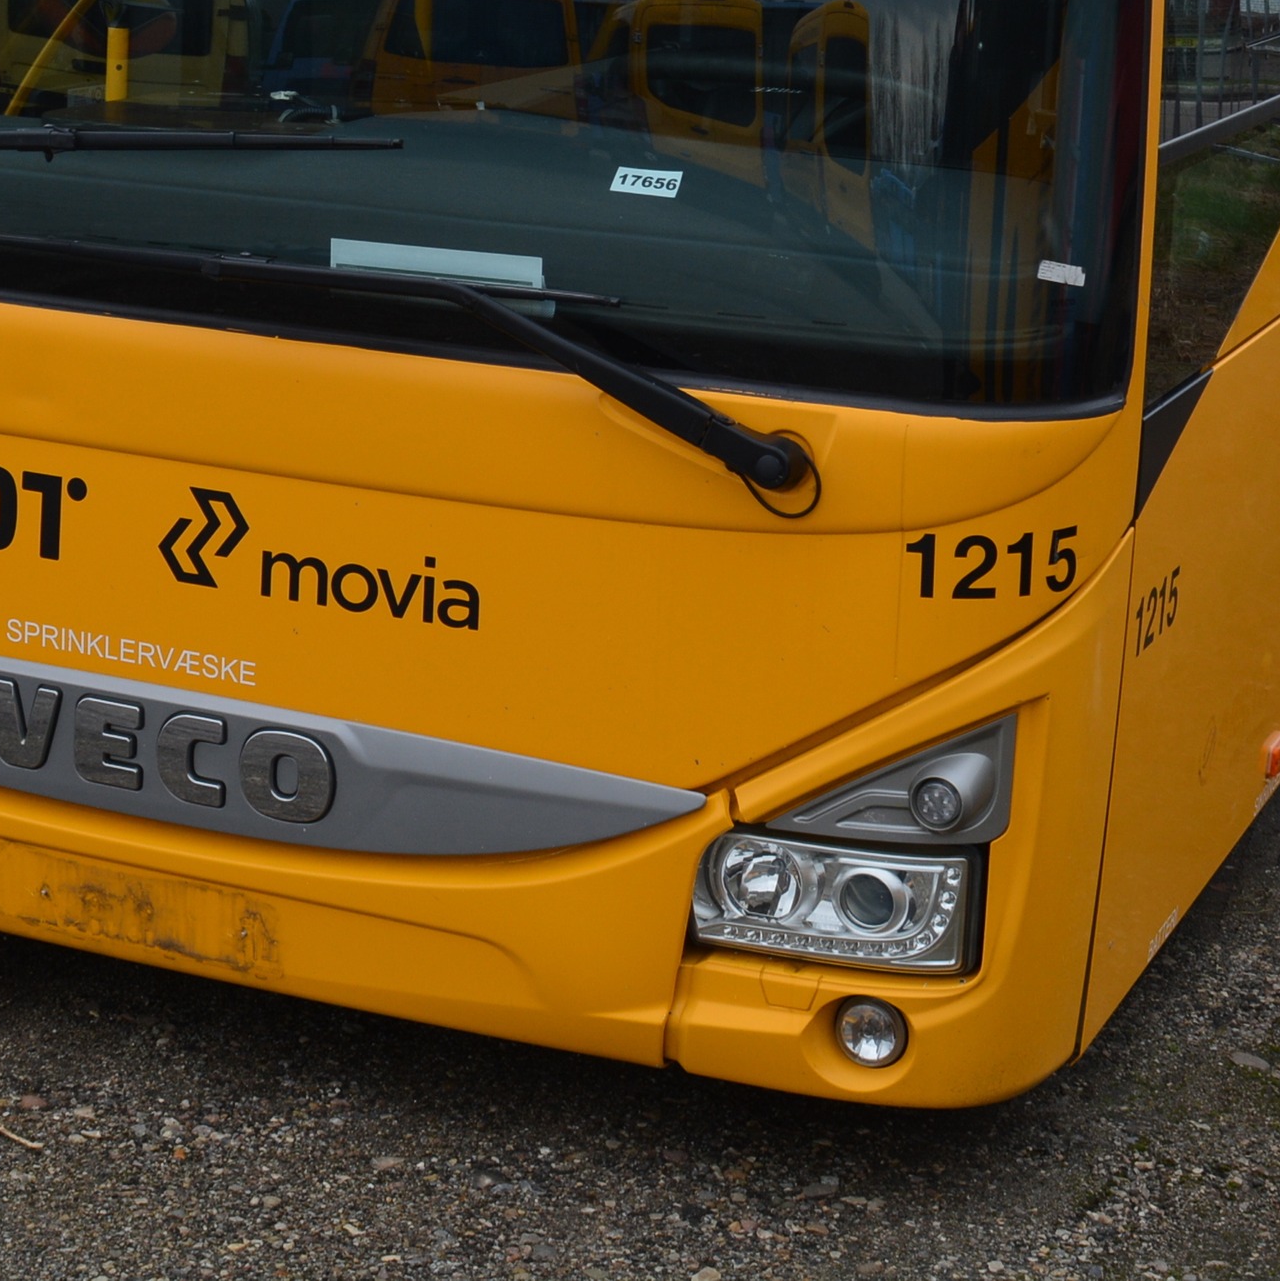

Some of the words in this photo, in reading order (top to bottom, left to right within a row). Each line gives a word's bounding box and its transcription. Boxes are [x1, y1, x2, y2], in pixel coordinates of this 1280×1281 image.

[618, 174, 678, 191] 17656
[260, 548, 481, 631] movia
[905, 524, 1078, 601] 1215
[1135, 565, 1181, 658] 1215
[5, 618, 257, 687] SPRINKLERVÆSKE
